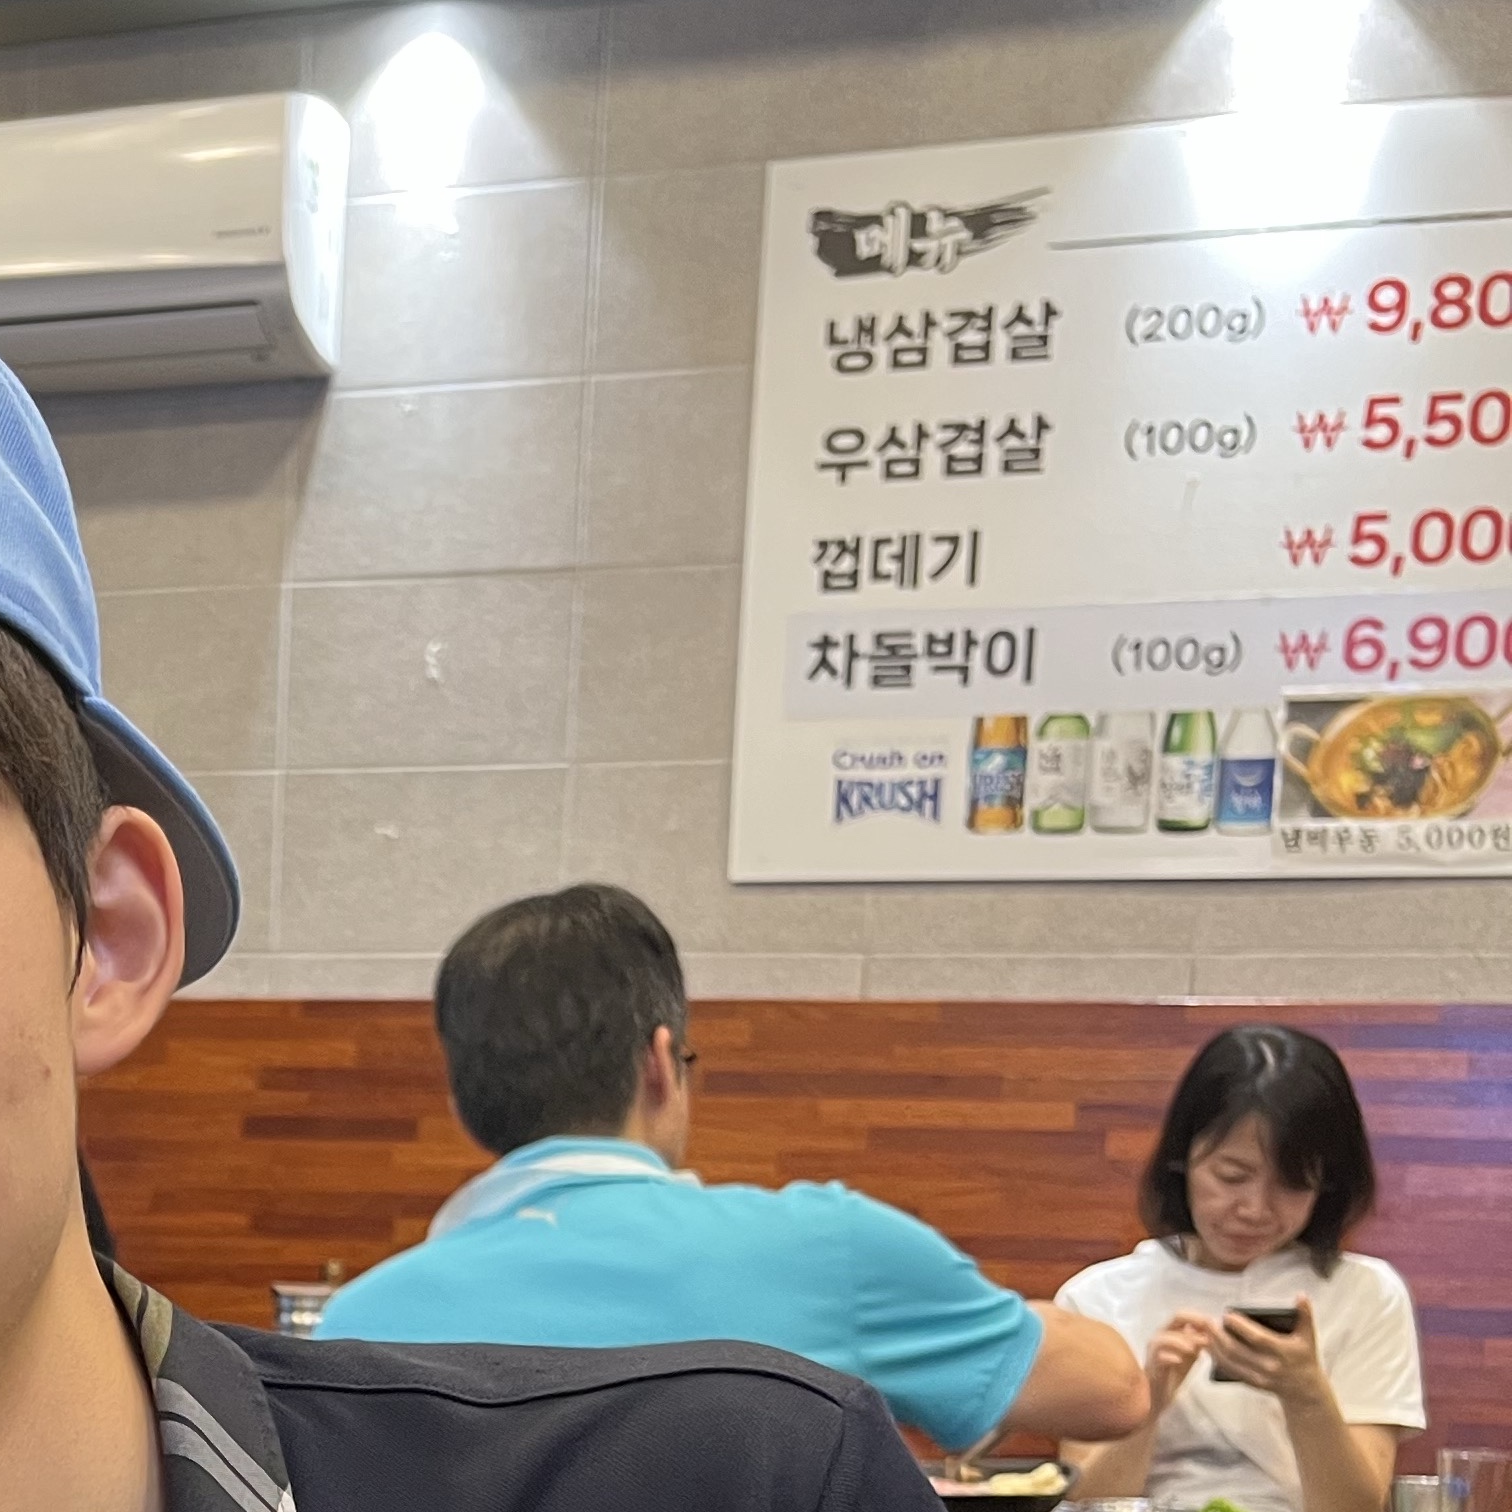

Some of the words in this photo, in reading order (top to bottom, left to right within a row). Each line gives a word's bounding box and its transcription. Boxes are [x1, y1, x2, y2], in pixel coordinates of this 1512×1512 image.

[852, 200, 973, 277] 메뉴
[828, 300, 1059, 374] 냉삼겹살
[1125, 295, 1266, 347] (200g)
[817, 412, 1052, 484] 우삼겹살
[1124, 411, 1257, 461] (100g)
[813, 528, 980, 590] 껍데기
[1347, 505, 1512, 577] 5,00
[807, 626, 1035, 690] 차돌박이
[1111, 630, 1243, 676] (100g)
[1342, 612, 1512, 682] 6,90
[834, 777, 942, 823] KRUSH
